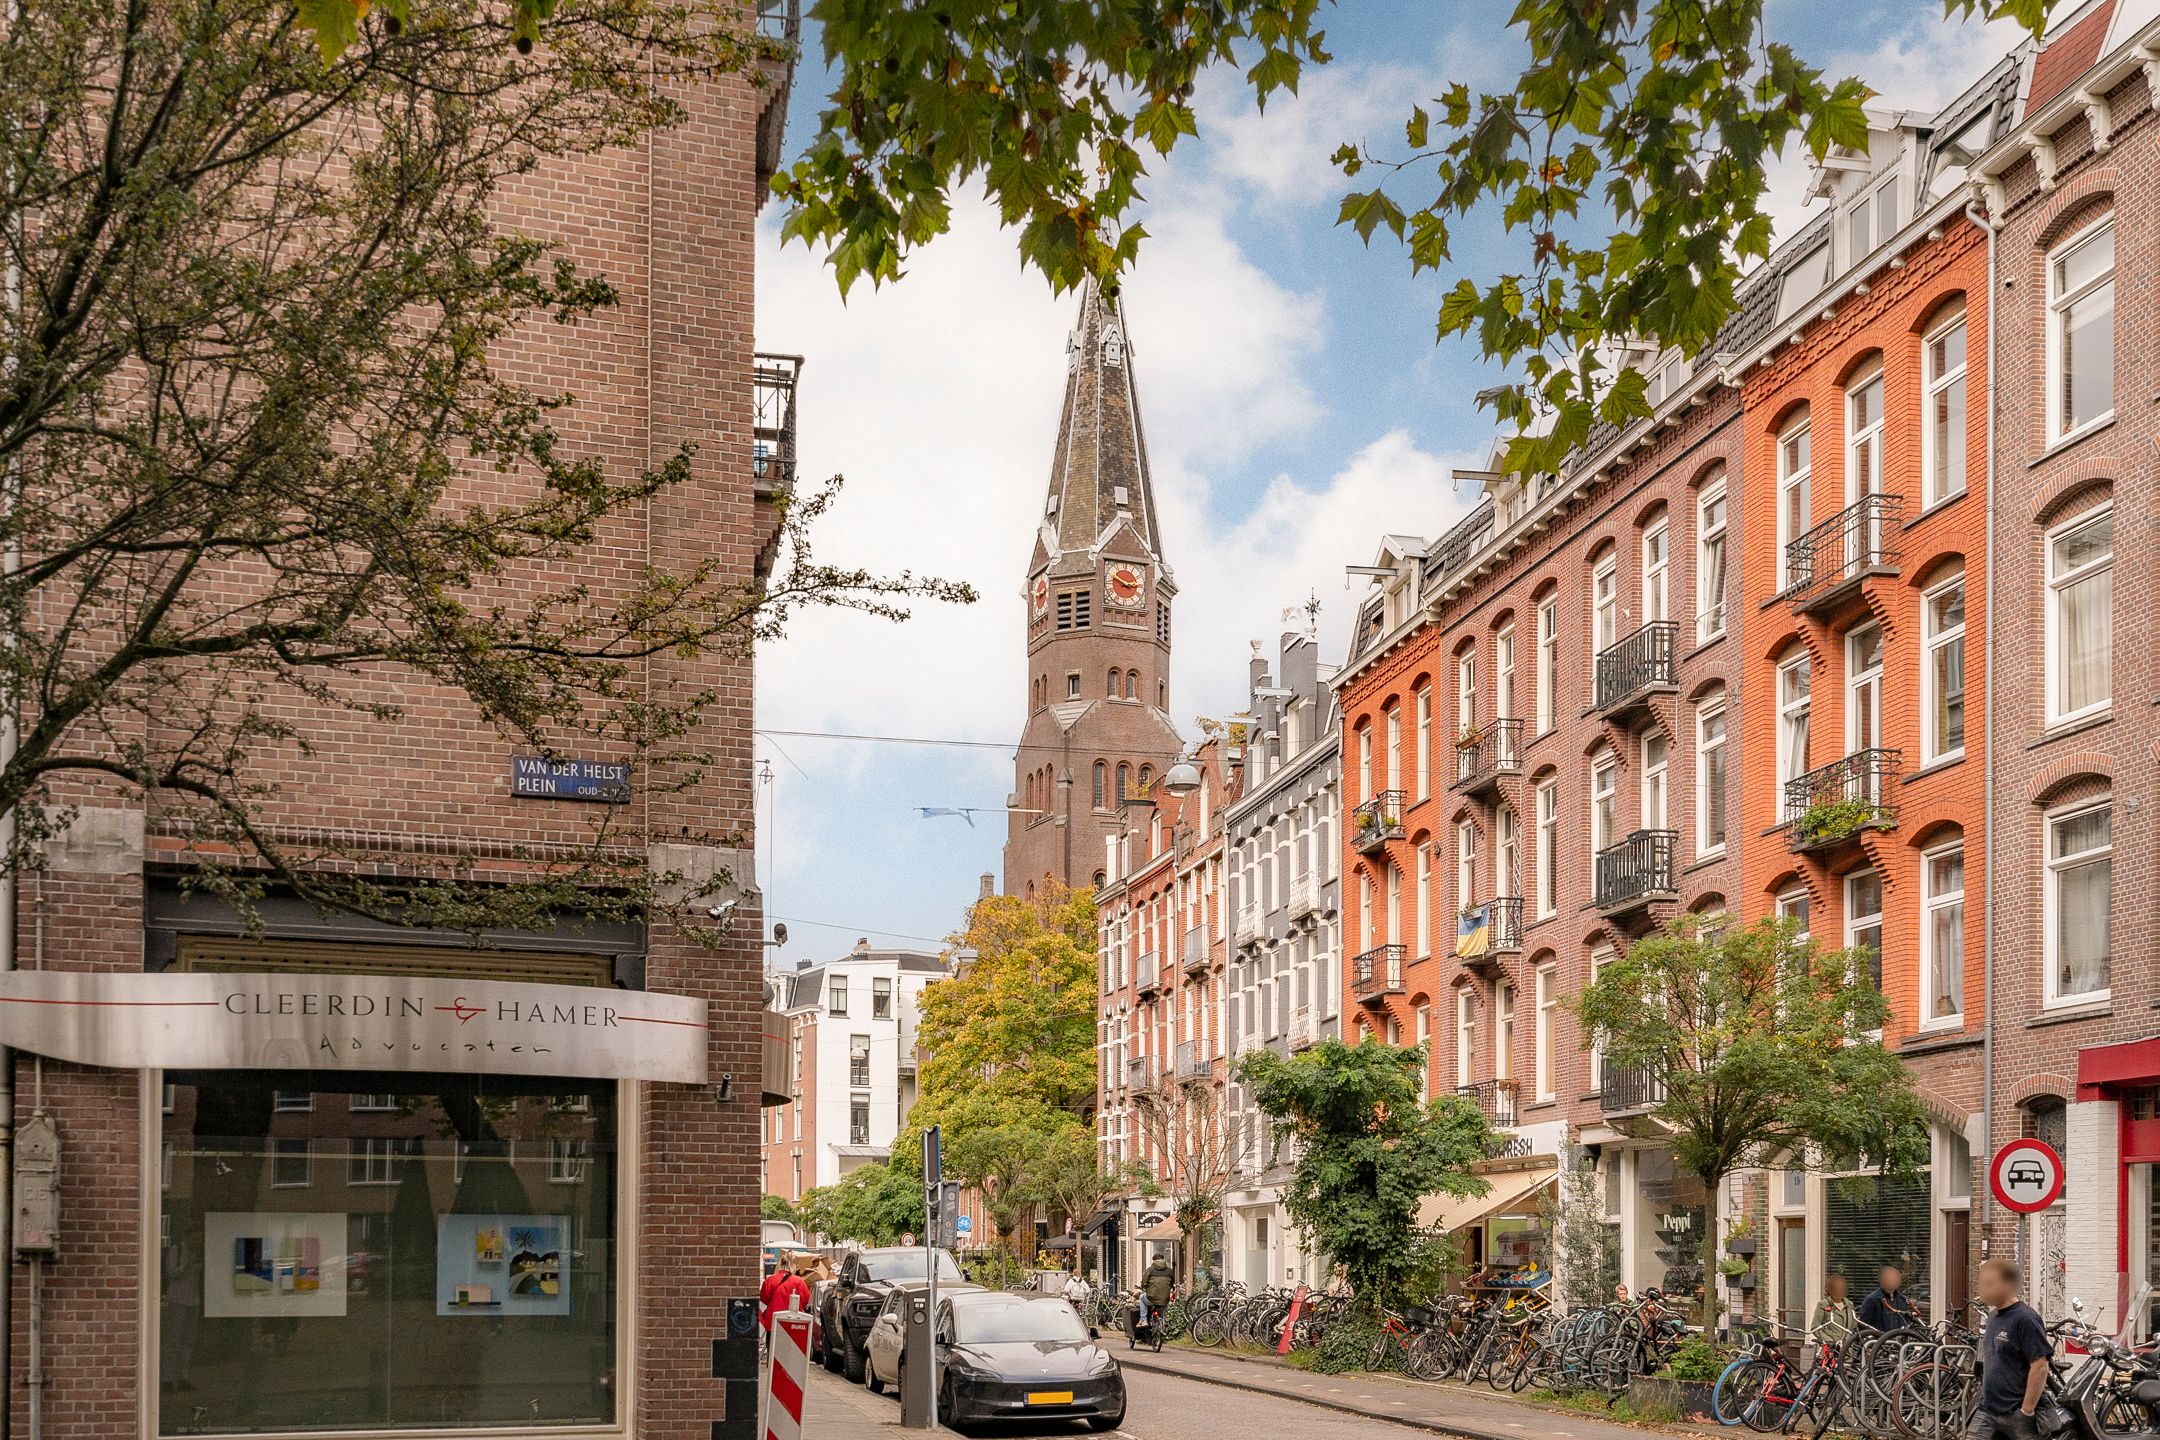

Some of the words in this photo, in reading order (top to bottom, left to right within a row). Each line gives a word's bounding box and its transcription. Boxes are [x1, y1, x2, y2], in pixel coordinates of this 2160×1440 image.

[519, 759, 548, 775] VAN
[552, 763, 579, 777] DER
[584, 765, 623, 780] HELST
[518, 778, 556, 793] PLEIN
[225, 992, 425, 1017] CLEERDIN
[497, 1000, 619, 1028] HAMER
[1663, 1211, 1691, 1233] Peppi
